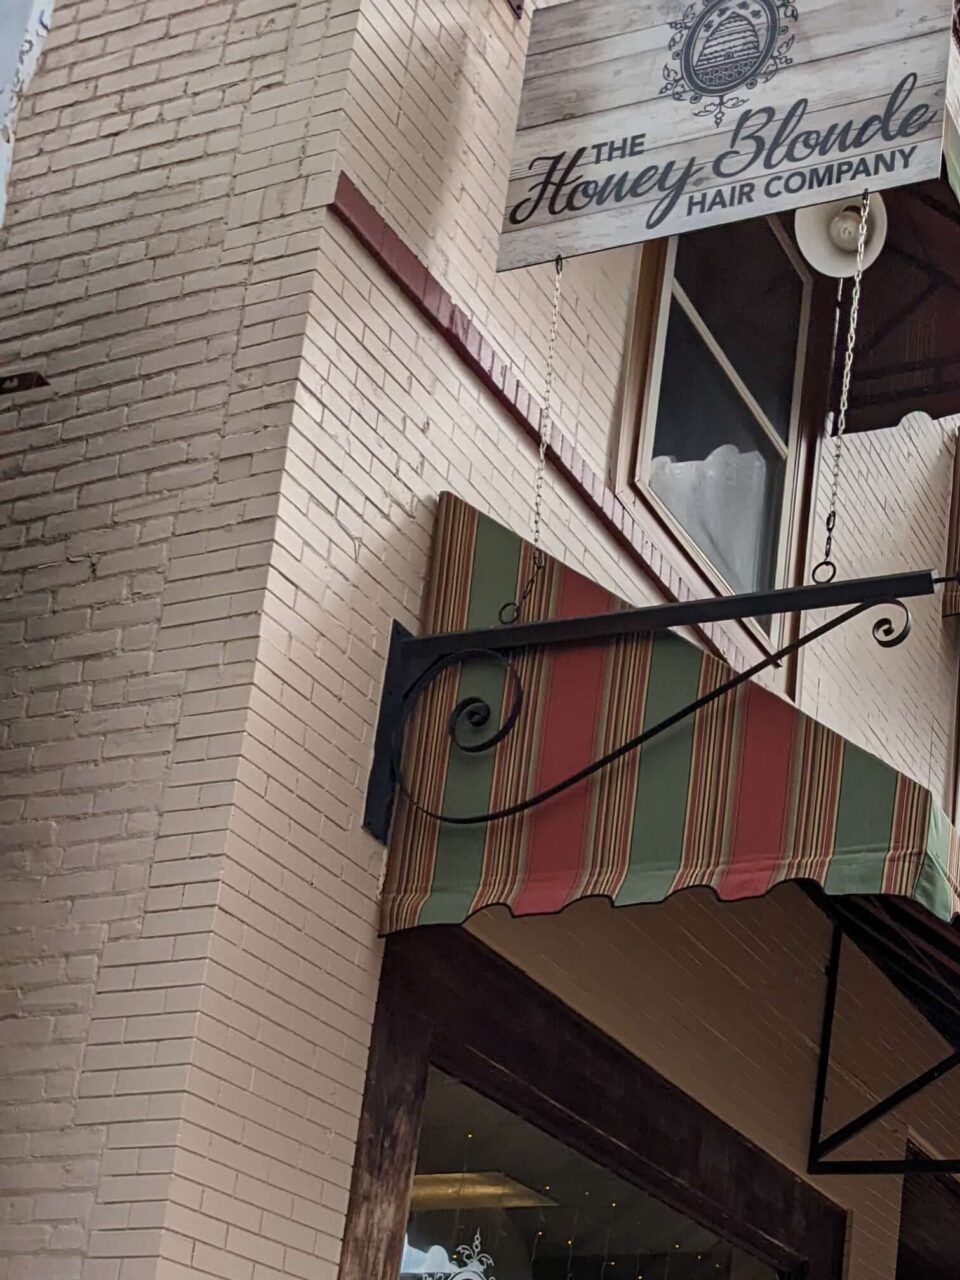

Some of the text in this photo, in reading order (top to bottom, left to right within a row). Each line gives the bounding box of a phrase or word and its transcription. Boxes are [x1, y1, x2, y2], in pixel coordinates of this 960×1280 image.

[509, 72, 938, 230] Honey Blonde
[591, 133, 646, 164] THE
[686, 146, 917, 216] HAIR COMPANY
